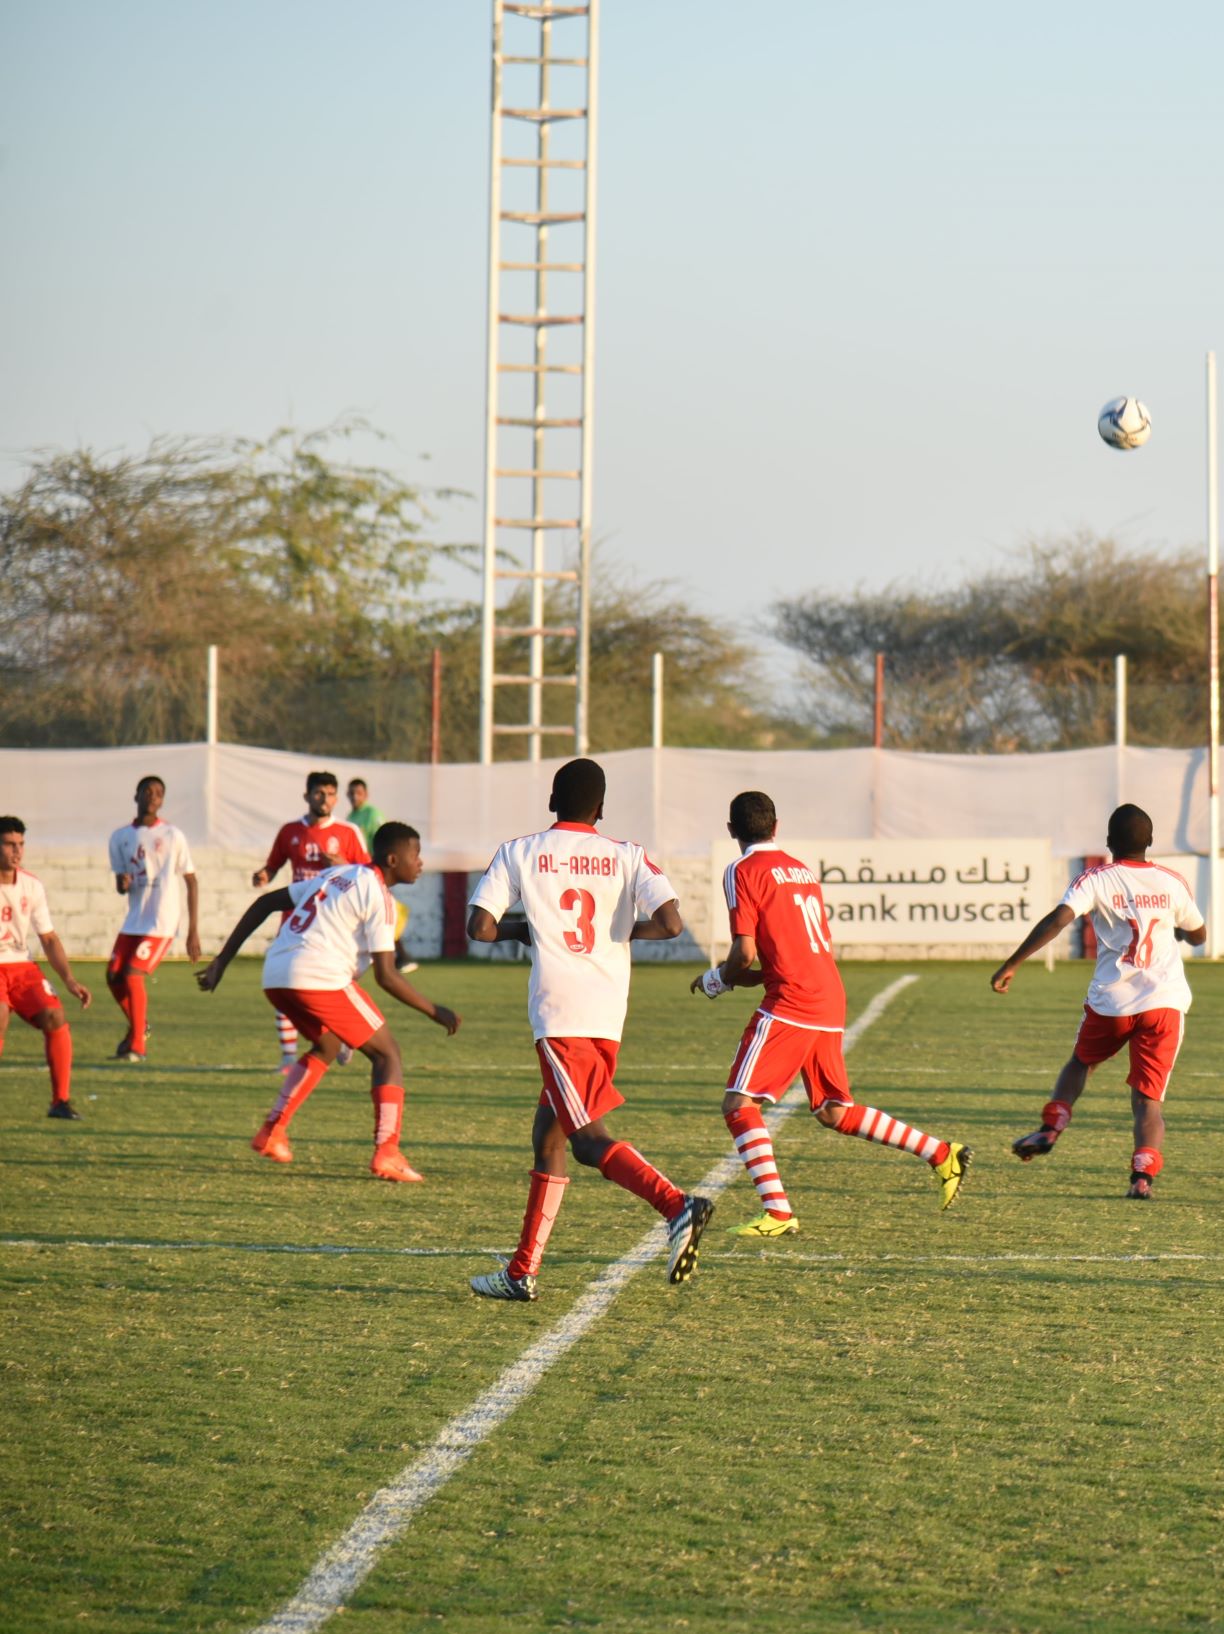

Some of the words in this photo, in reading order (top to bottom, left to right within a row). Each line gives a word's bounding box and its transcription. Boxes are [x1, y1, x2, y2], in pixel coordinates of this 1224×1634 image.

[538, 854, 616, 877] AL-ARABI
[819, 857, 947, 886] مسقط
[956, 856, 1031, 891] بنك
[908, 898, 1031, 922] muscat
[1112, 894, 1171, 909] AL-ARABI
[559, 888, 596, 954] 3
[135, 940, 152, 960] 6
